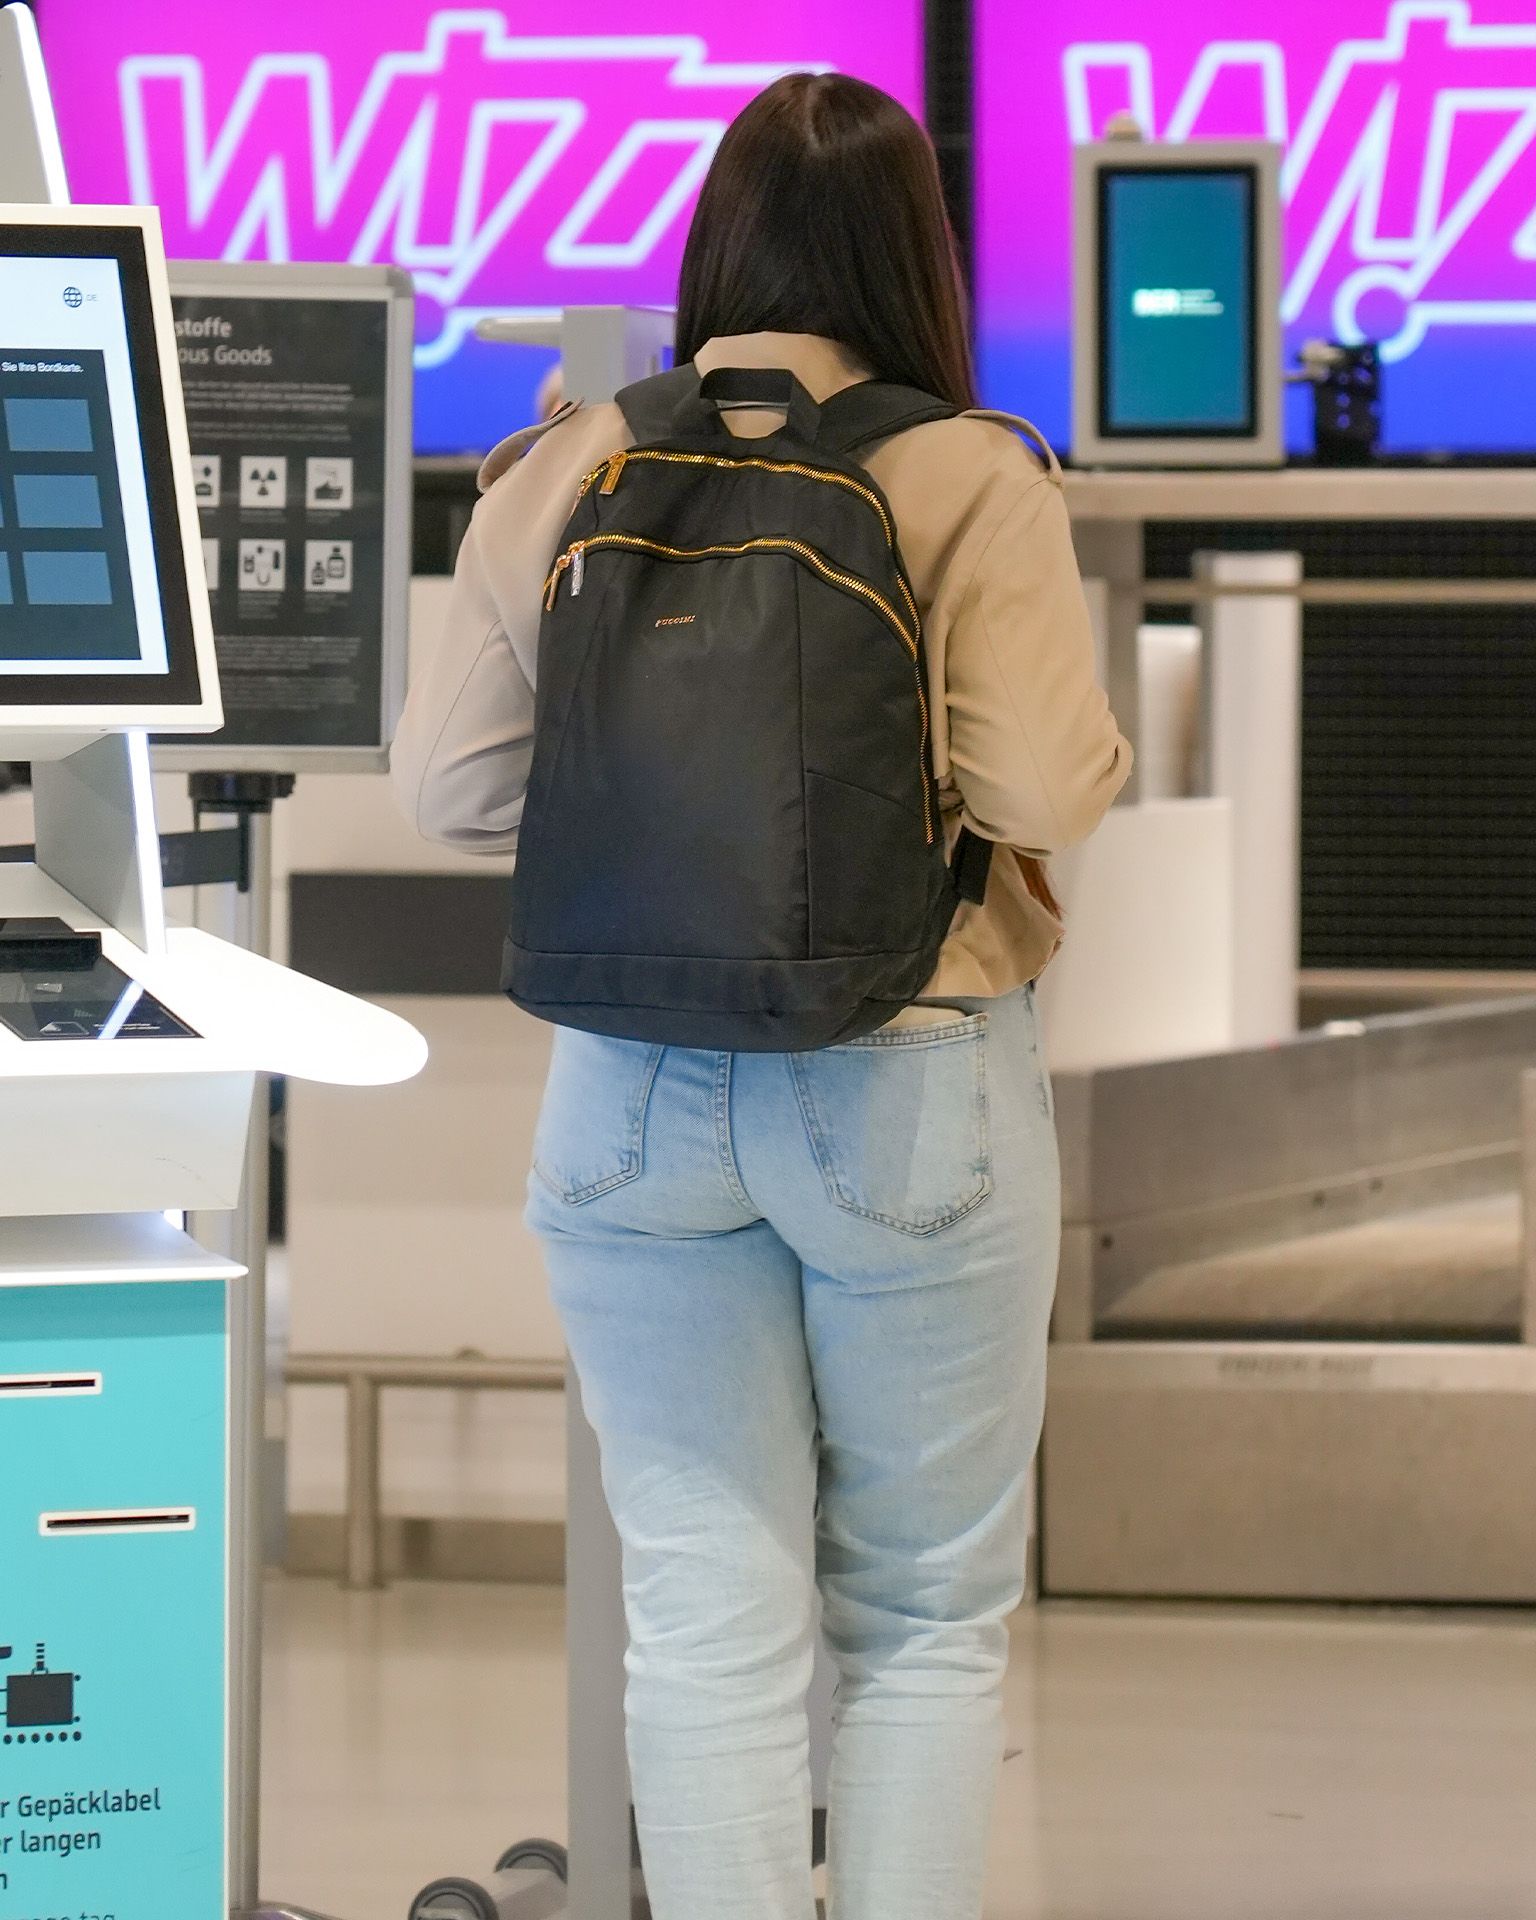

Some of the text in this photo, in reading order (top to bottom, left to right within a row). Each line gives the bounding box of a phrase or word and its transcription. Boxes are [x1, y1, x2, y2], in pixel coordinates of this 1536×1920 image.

[214, 344, 273, 366] Goods
[1, 361, 84, 373] Sie Ihre Bordkarte.
[655, 615, 696, 628] PUCCINI
[18, 1787, 160, 1822] Gepäcklabel
[20, 1829, 101, 1858] langen
